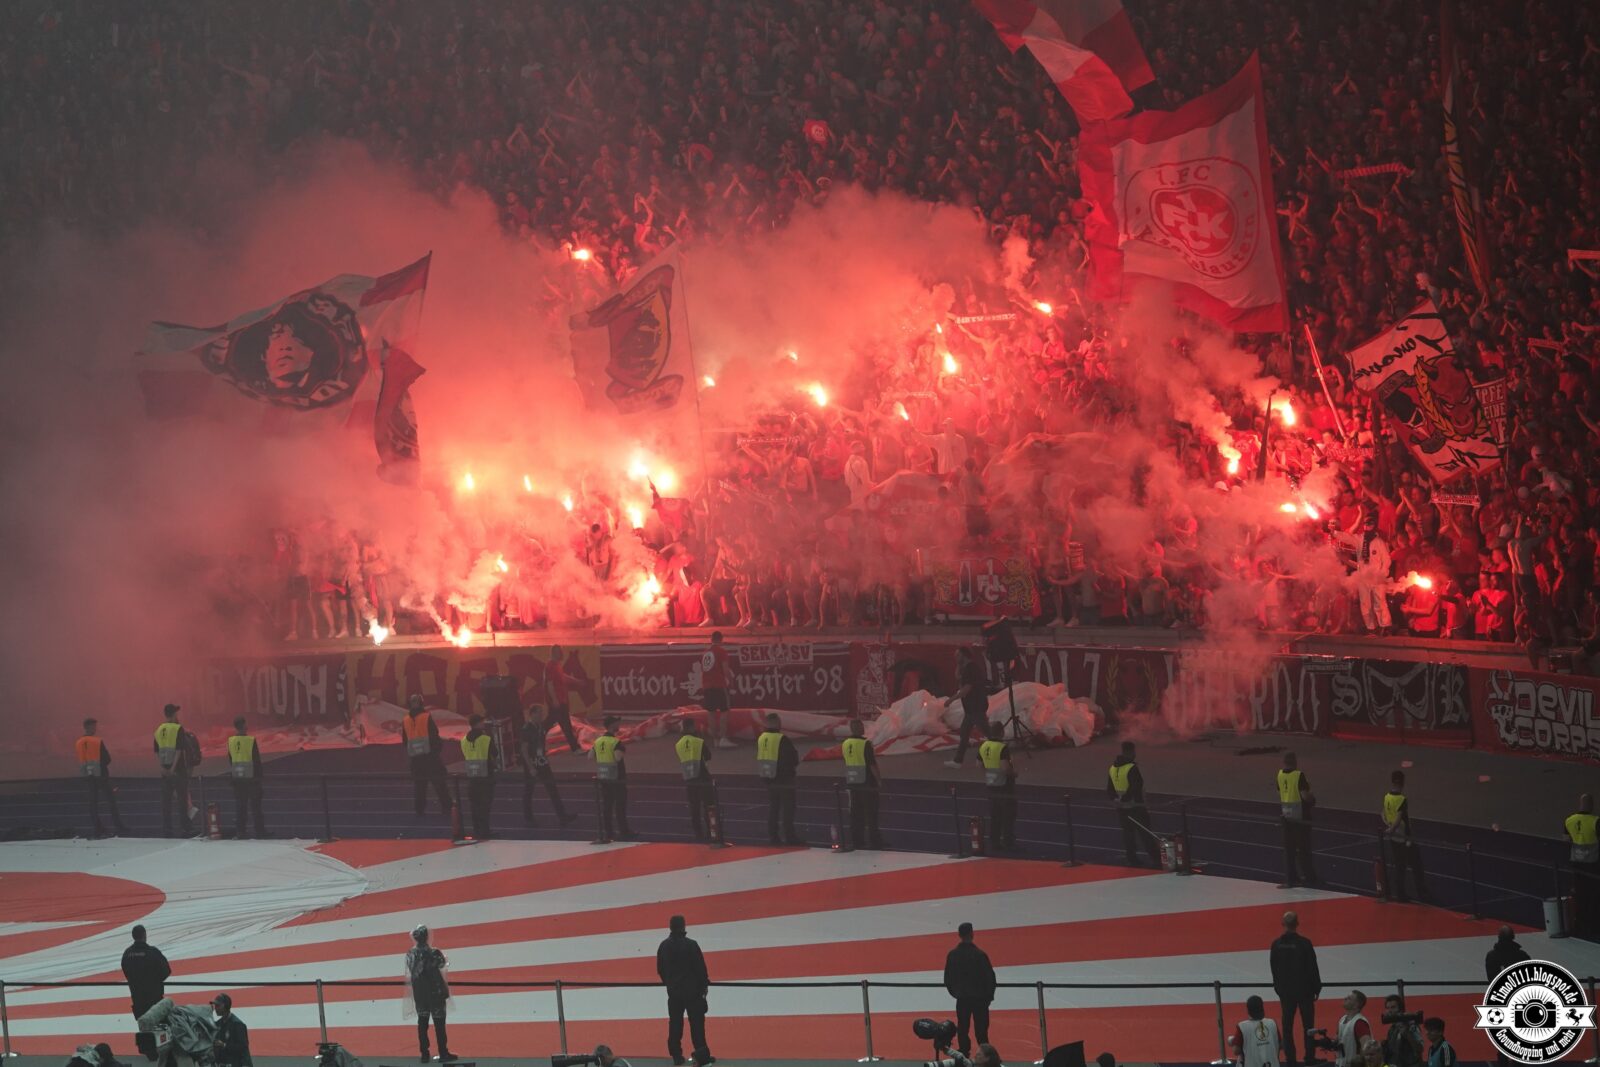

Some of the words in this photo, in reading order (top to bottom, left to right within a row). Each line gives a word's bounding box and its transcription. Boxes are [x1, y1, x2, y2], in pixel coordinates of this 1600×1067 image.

[740, 645, 771, 662] SEK
[791, 644, 811, 661] SV
[236, 663, 328, 718] YOUTH
